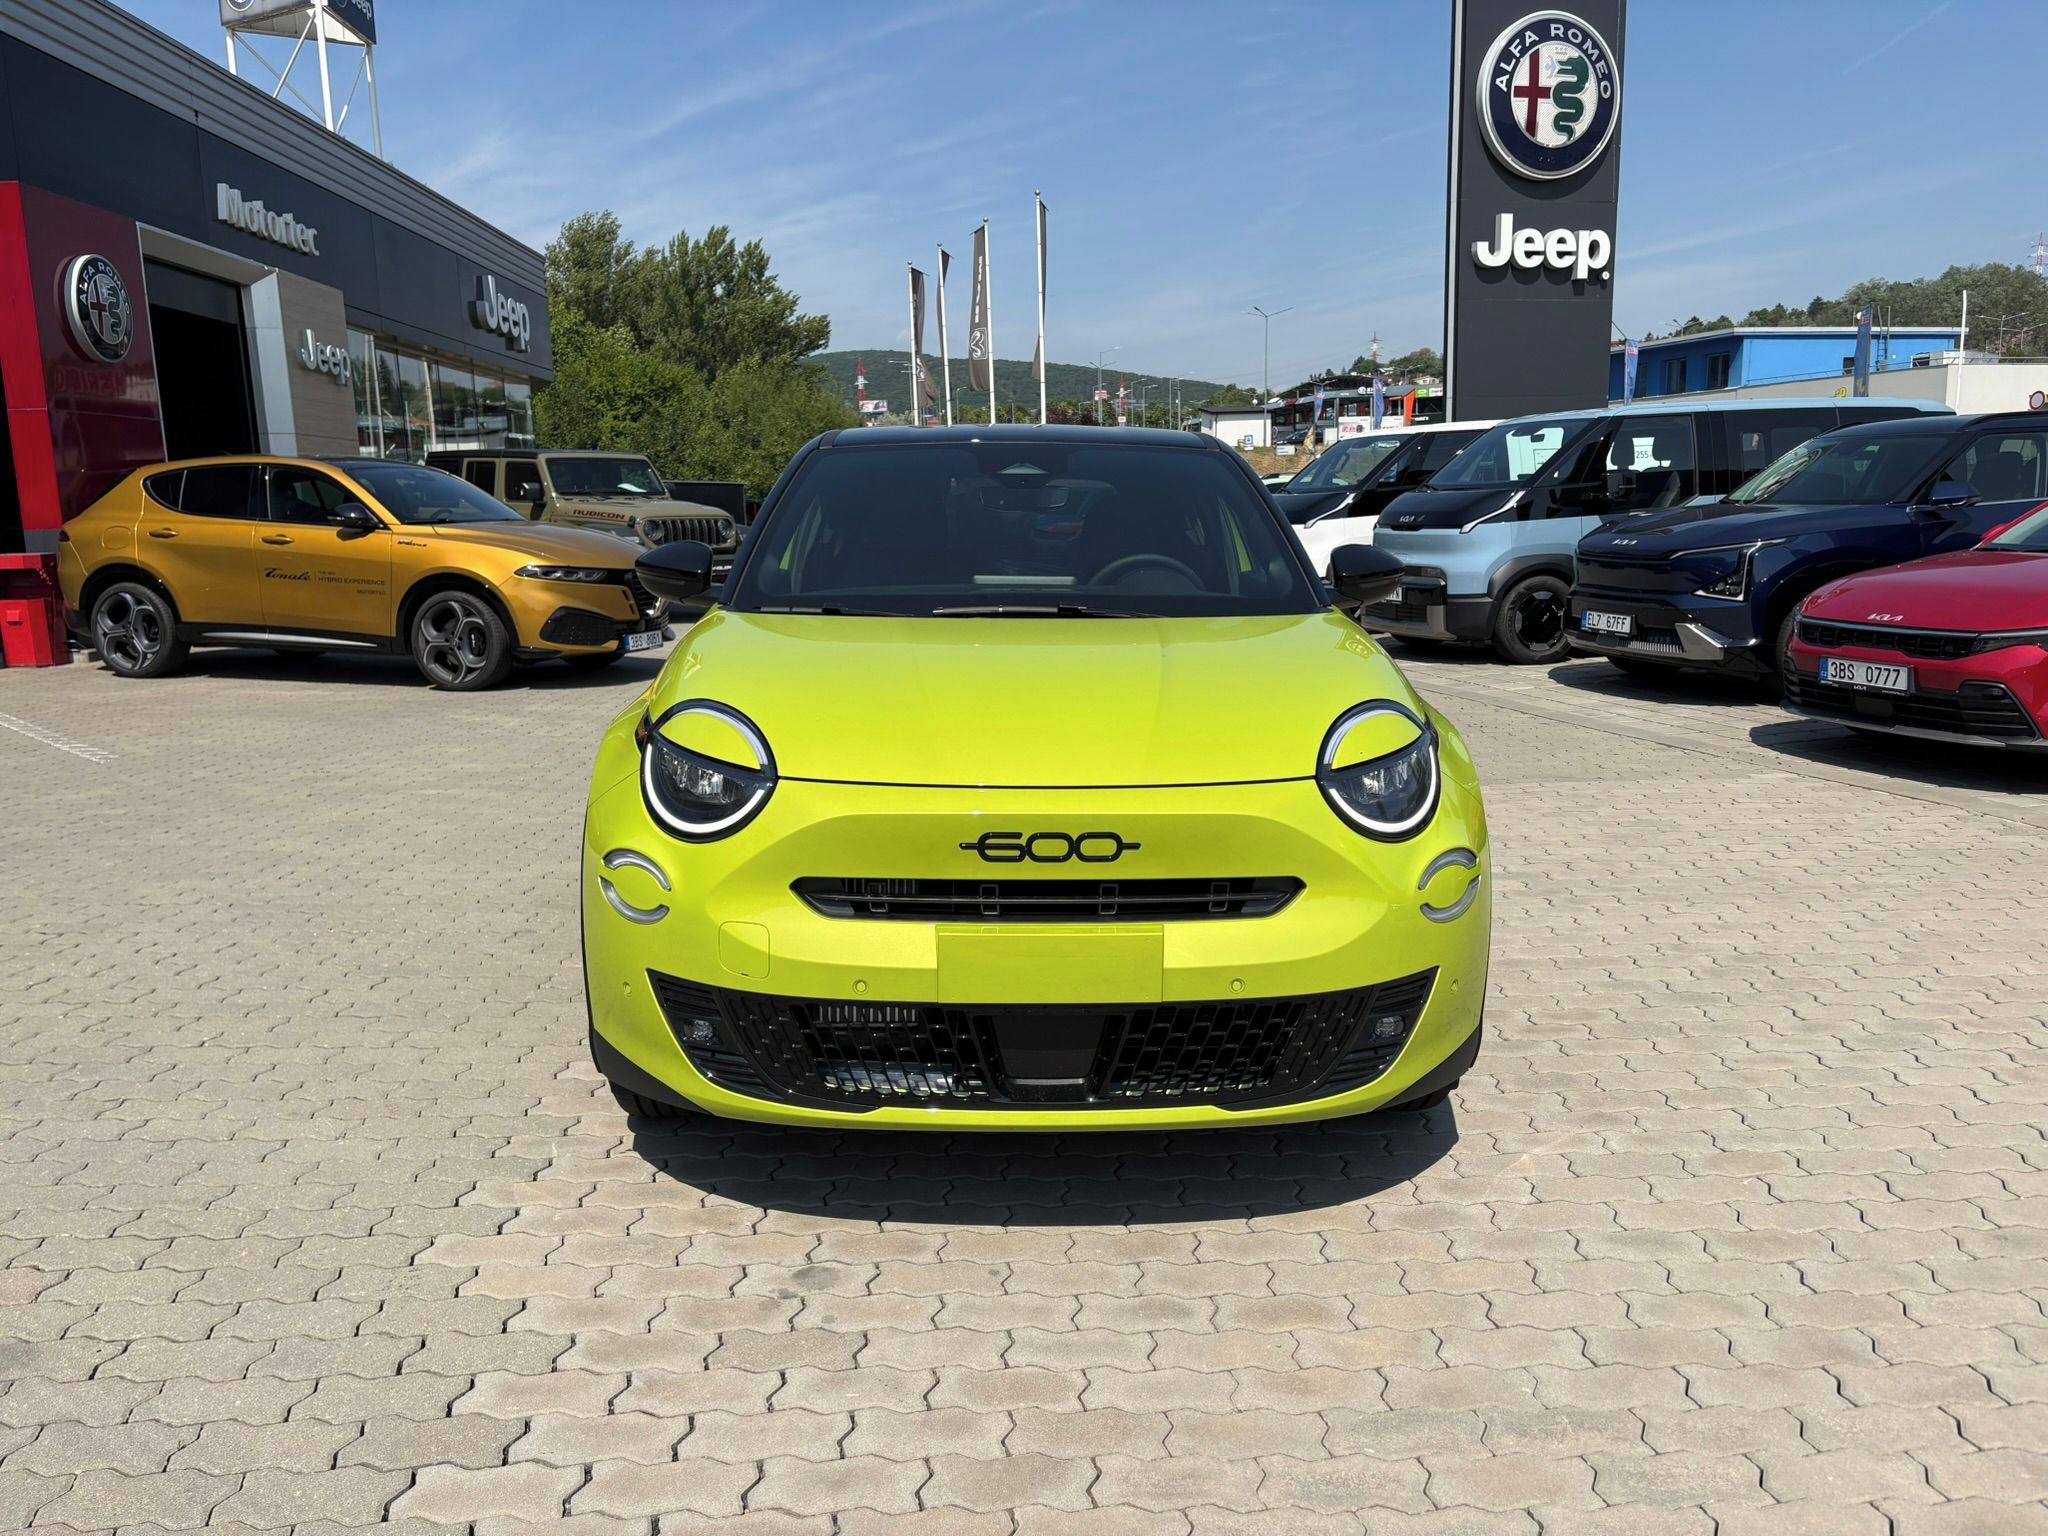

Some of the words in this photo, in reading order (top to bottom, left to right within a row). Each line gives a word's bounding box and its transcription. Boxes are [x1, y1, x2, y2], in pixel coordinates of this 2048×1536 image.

[1495, 30, 1540, 93] ALFA
[1550, 23, 1612, 99] ROMEO
[217, 183, 320, 257] Motortec
[1472, 213, 1612, 281] Jeep
[79, 264, 96, 305] ALFA
[474, 275, 531, 353] Jeep
[300, 328, 350, 385] Jeep
[573, 509, 625, 520] RUBICON
[264, 568, 311, 581] Tonale
[1587, 612, 1602, 627] EL7
[1606, 614, 1627, 631] 67FF
[1867, 613, 1904, 622] KIA
[630, 635, 644, 648] 3BS
[1830, 660, 1855, 680] 3BS
[1865, 665, 1901, 687] 0777
[976, 831, 1125, 863] 600
